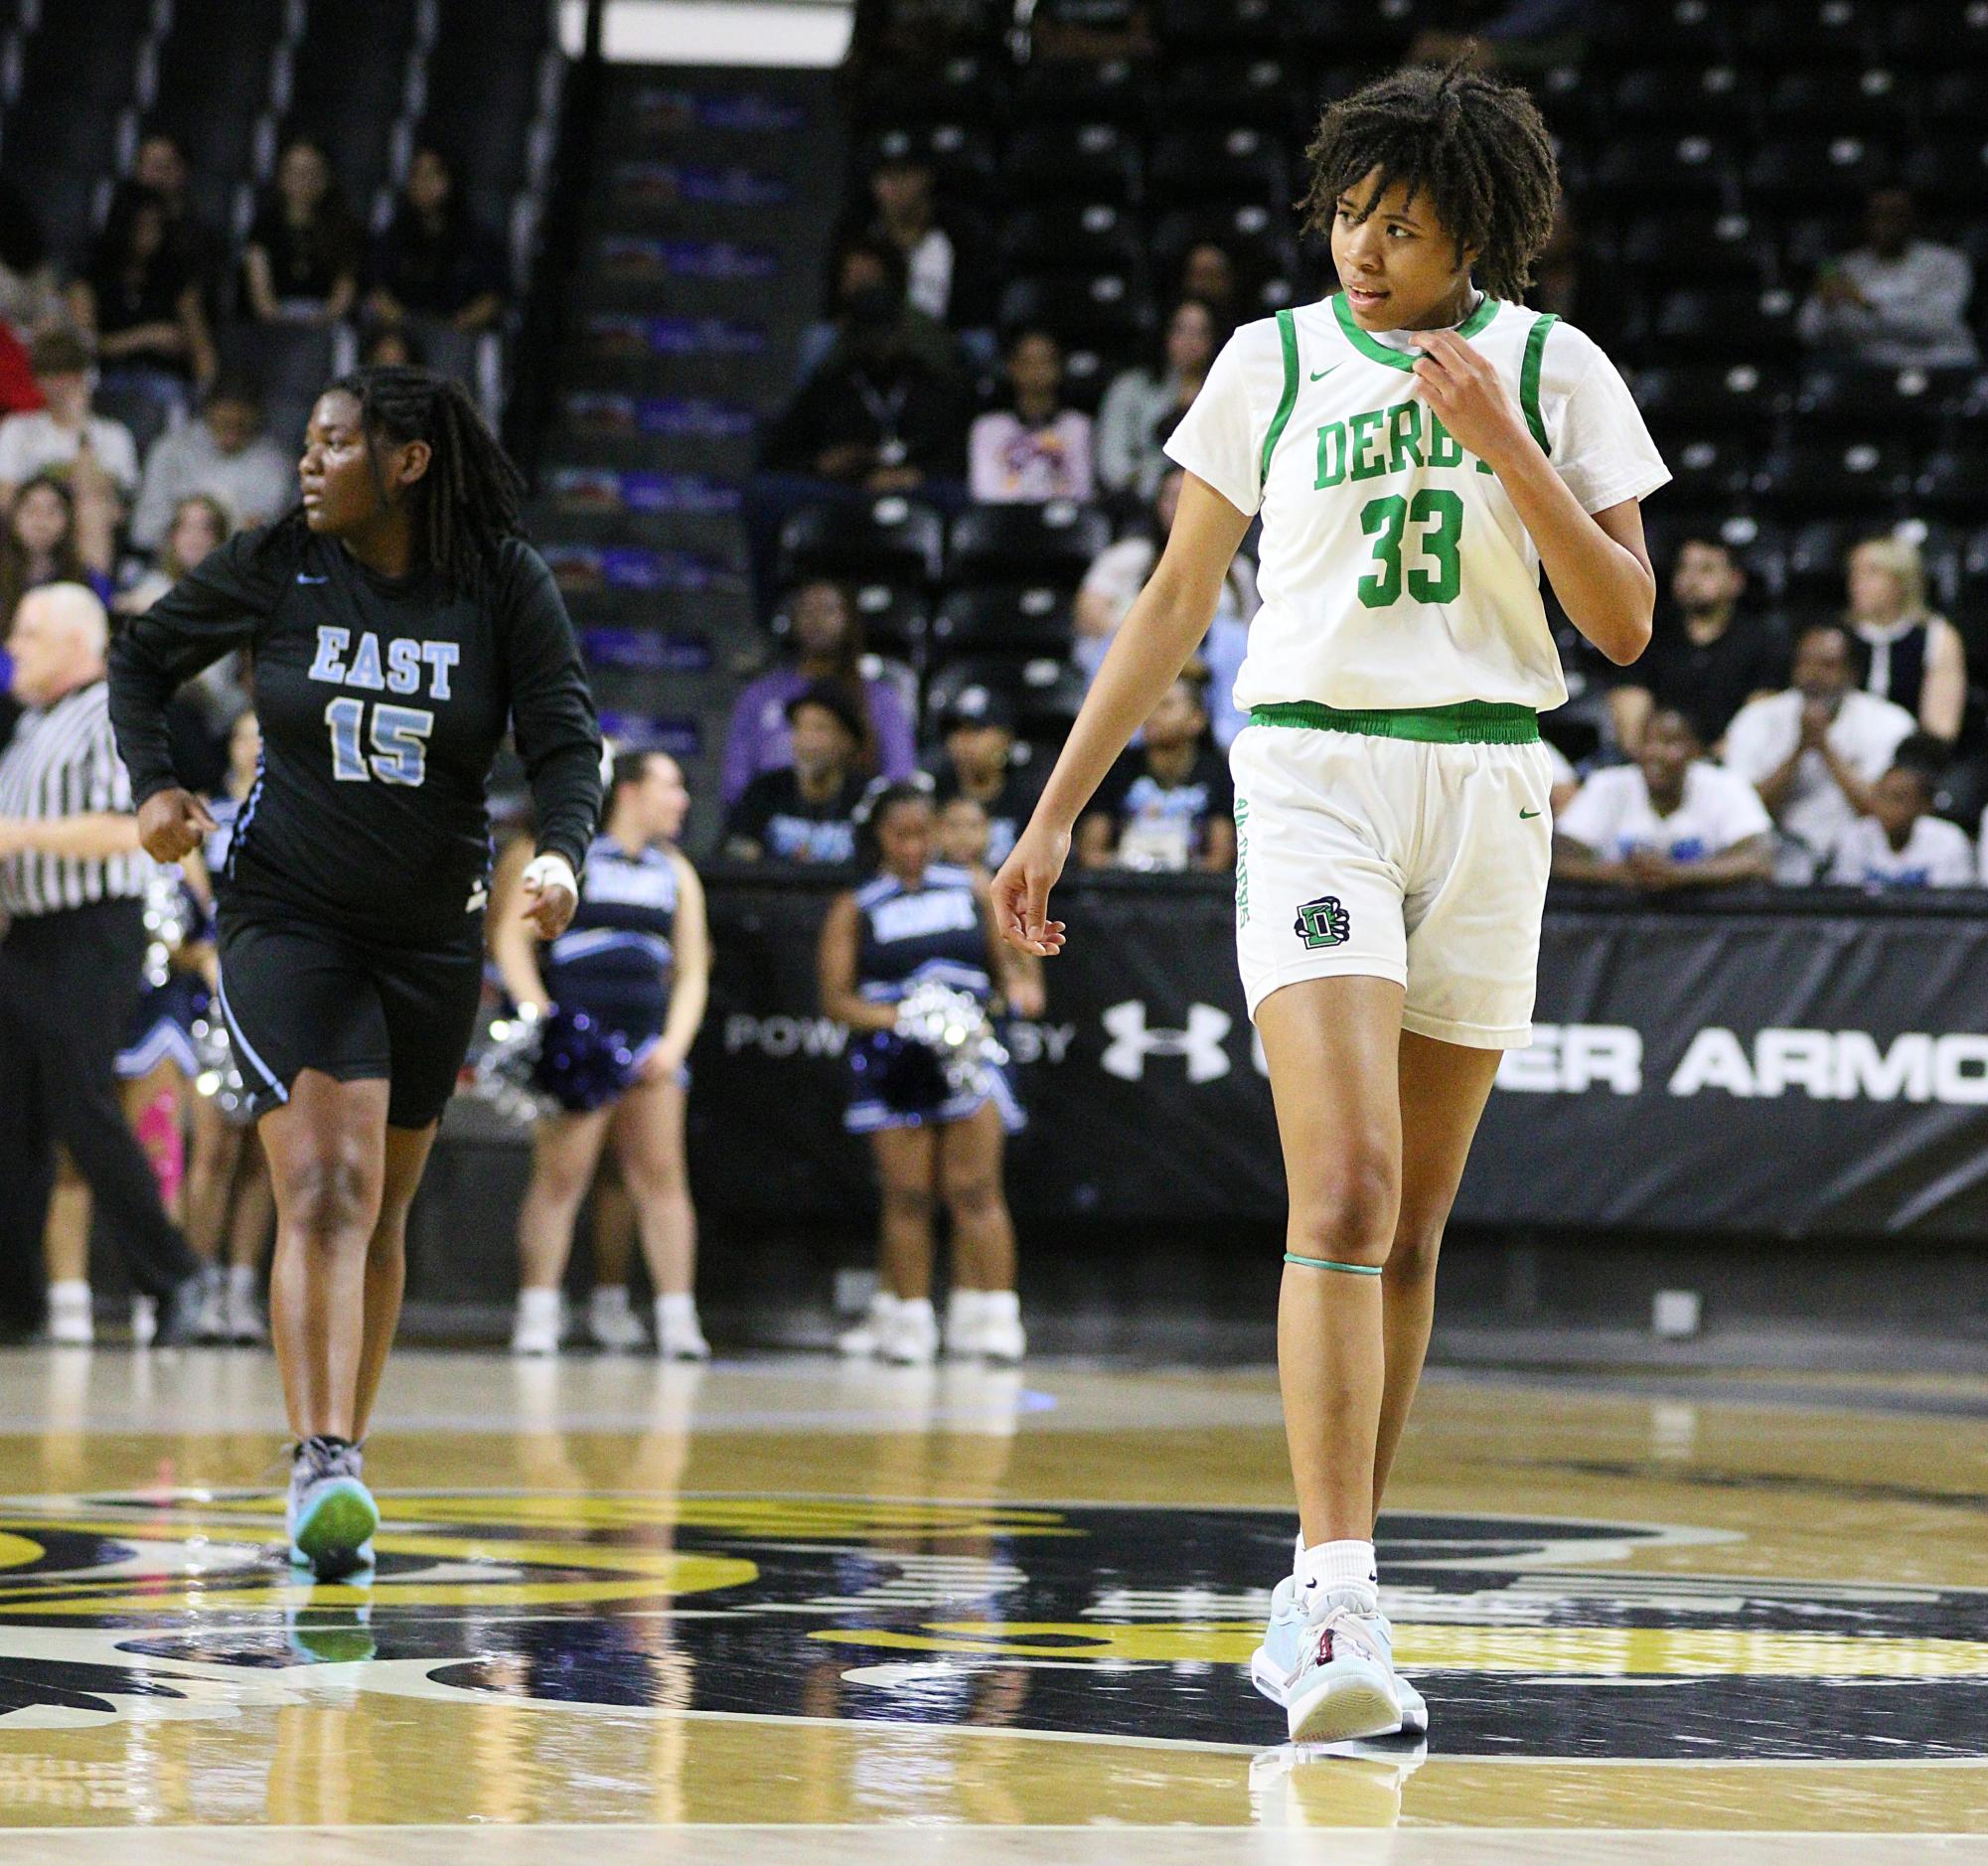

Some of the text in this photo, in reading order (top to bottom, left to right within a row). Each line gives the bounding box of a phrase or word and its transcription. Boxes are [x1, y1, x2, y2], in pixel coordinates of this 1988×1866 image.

[1313, 399, 1494, 491] DERB
[1357, 488, 1464, 609] 33
[308, 624, 460, 701] EAST
[324, 696, 435, 788] 15
[724, 1013, 849, 1057] POW
